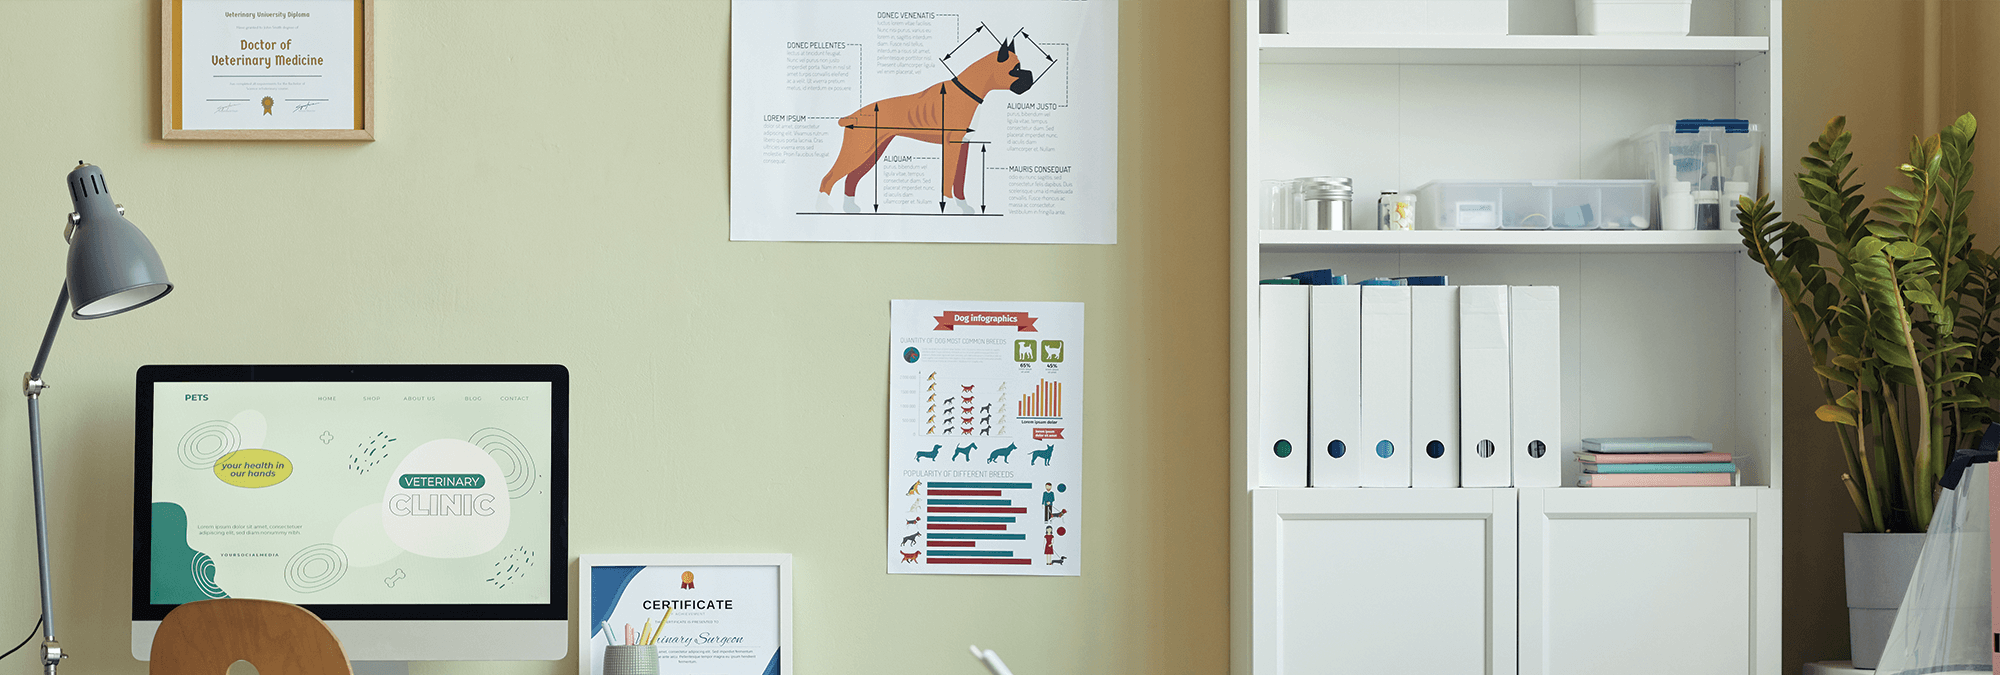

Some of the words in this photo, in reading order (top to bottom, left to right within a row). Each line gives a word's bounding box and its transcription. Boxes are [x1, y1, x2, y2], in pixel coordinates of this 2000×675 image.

[241, 39, 276, 50] Doctor
[280, 39, 292, 50] of
[211, 55, 271, 69] Veterinary
[275, 55, 324, 66] Medicine
[954, 314, 969, 323] Dog
[971, 314, 1018, 323] infographics
[404, 477, 480, 486] VETERINARY
[389, 493, 495, 516] CLINIC
[642, 600, 733, 610] CERTIFICATE
[694, 632, 744, 647] Surgeon
